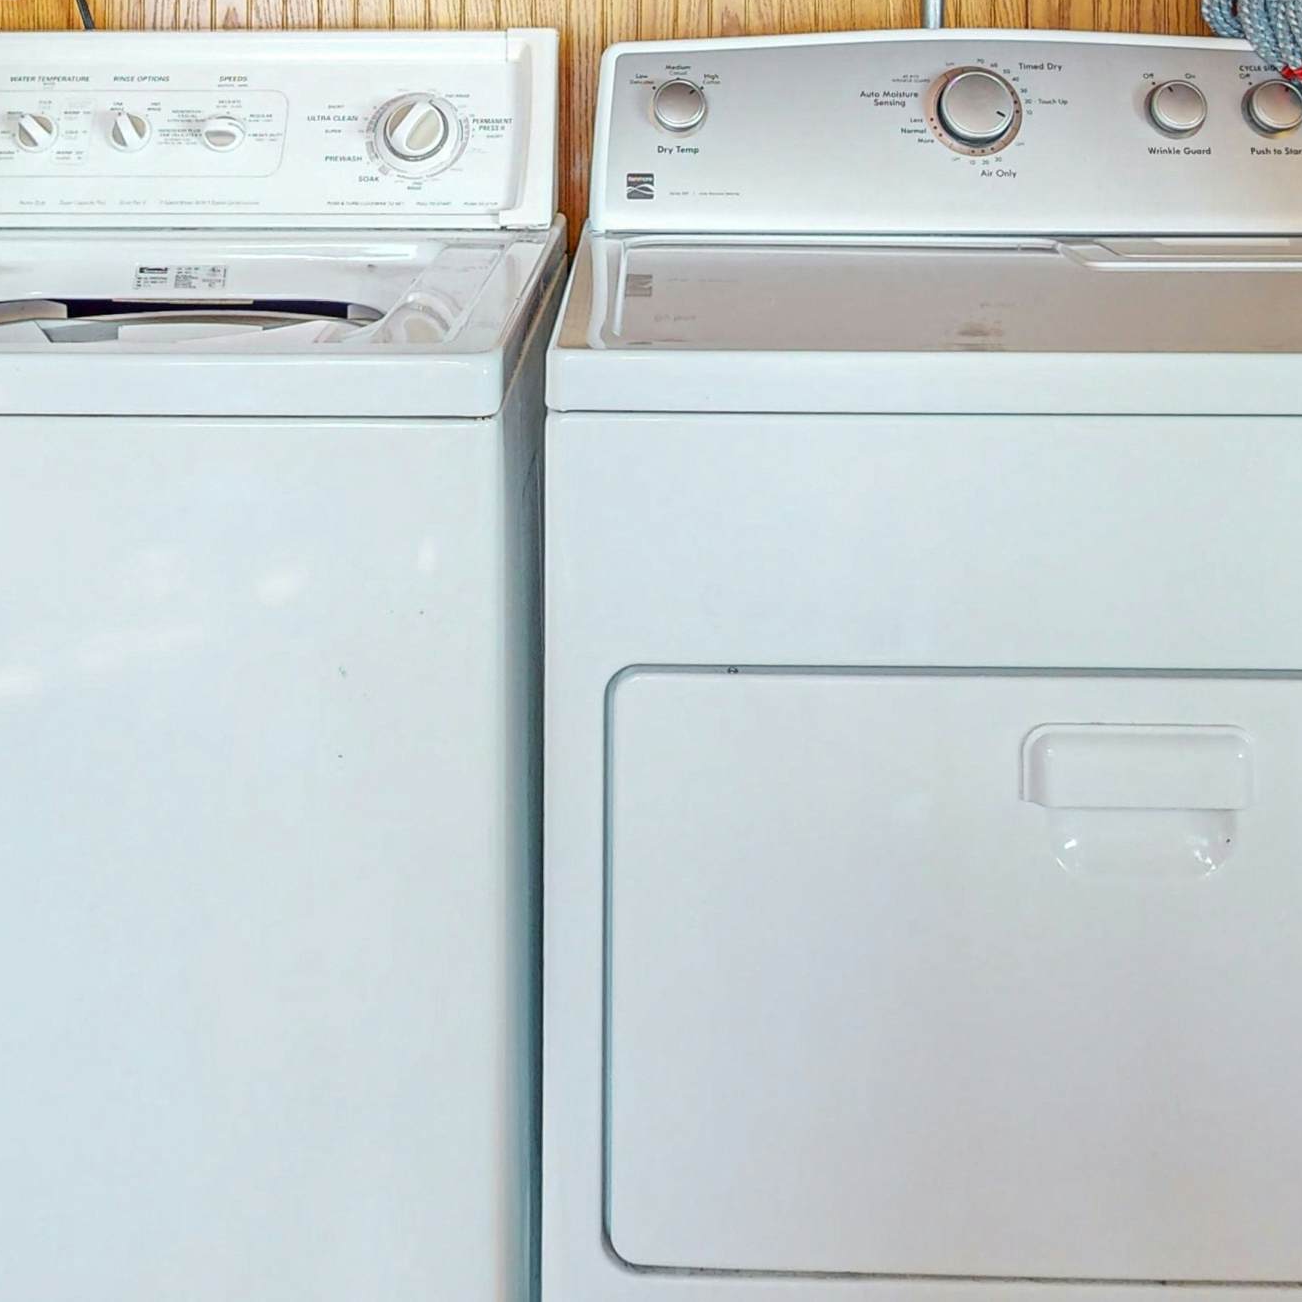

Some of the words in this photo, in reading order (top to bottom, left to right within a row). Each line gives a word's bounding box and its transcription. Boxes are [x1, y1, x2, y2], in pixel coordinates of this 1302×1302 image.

[1019, 62, 1045, 71] Timed
[1046, 62, 1063, 72] Dry
[859, 90, 881, 98] Auto
[883, 90, 919, 98] Moisture
[873, 99, 907, 109] Sensing
[472, 117, 513, 125] PERMANENT
[657, 145, 674, 155] Dry
[675, 145, 700, 155] Temp
[1148, 147, 1181, 155] Wrinkle
[1183, 147, 1212, 155] Guard
[1250, 147, 1271, 155] Push
[1273, 147, 1283, 155] to
[324, 154, 363, 162] PREWASH
[981, 169, 994, 178] Air
[995, 169, 1018, 180] Only
[358, 175, 380, 183] SOAK
